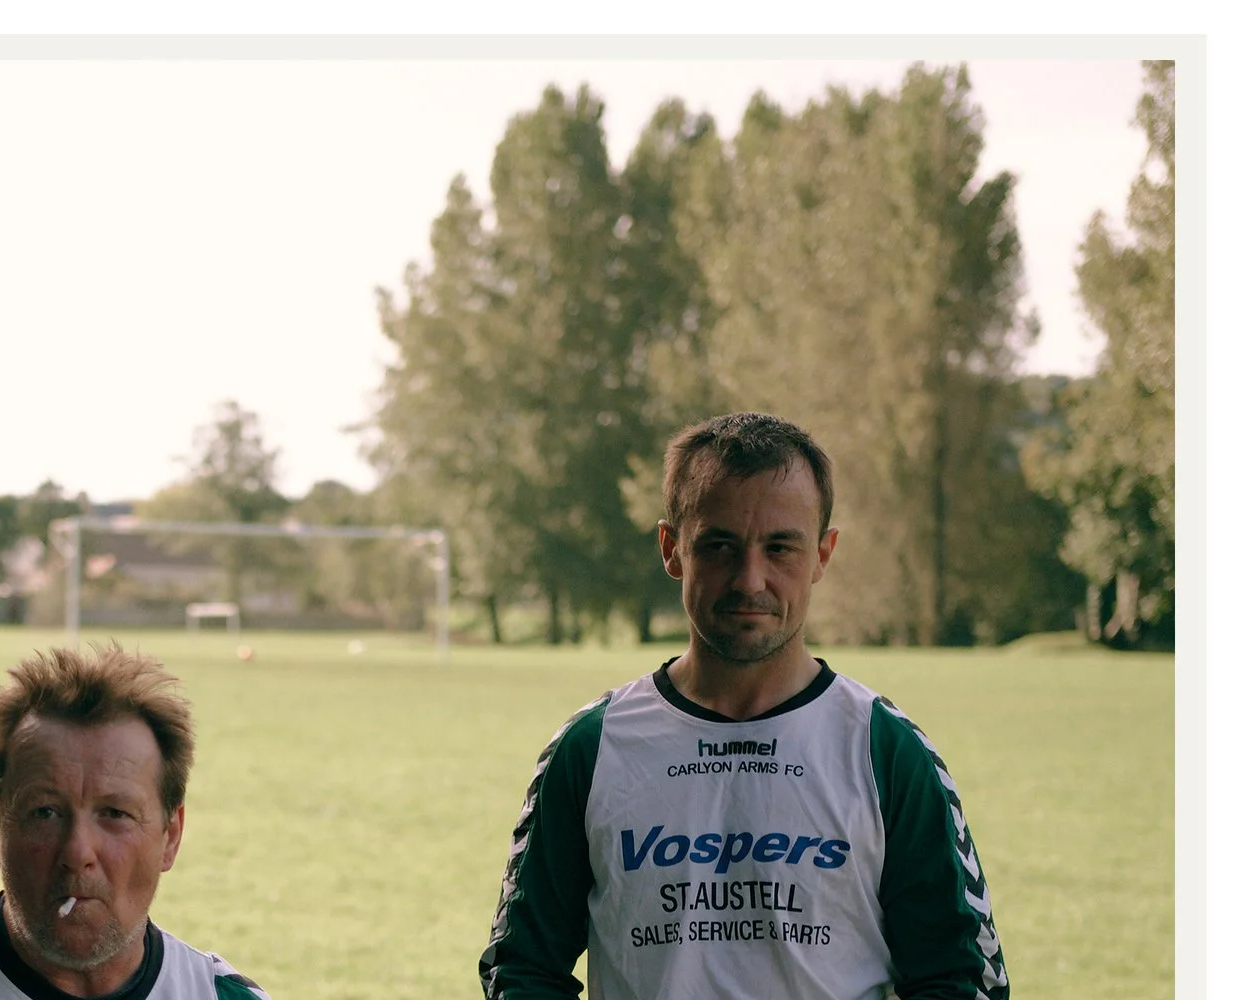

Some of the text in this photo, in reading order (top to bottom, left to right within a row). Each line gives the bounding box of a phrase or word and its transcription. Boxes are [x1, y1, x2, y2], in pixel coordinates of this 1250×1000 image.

[698, 738, 777, 757] hummel
[667, 761, 804, 777] CARLYON ARMS FC
[620, 825, 851, 874] Vospers
[660, 881, 803, 913] ST.AUSTELL
[631, 920, 831, 947] SALES, SERVICE & PARTS
